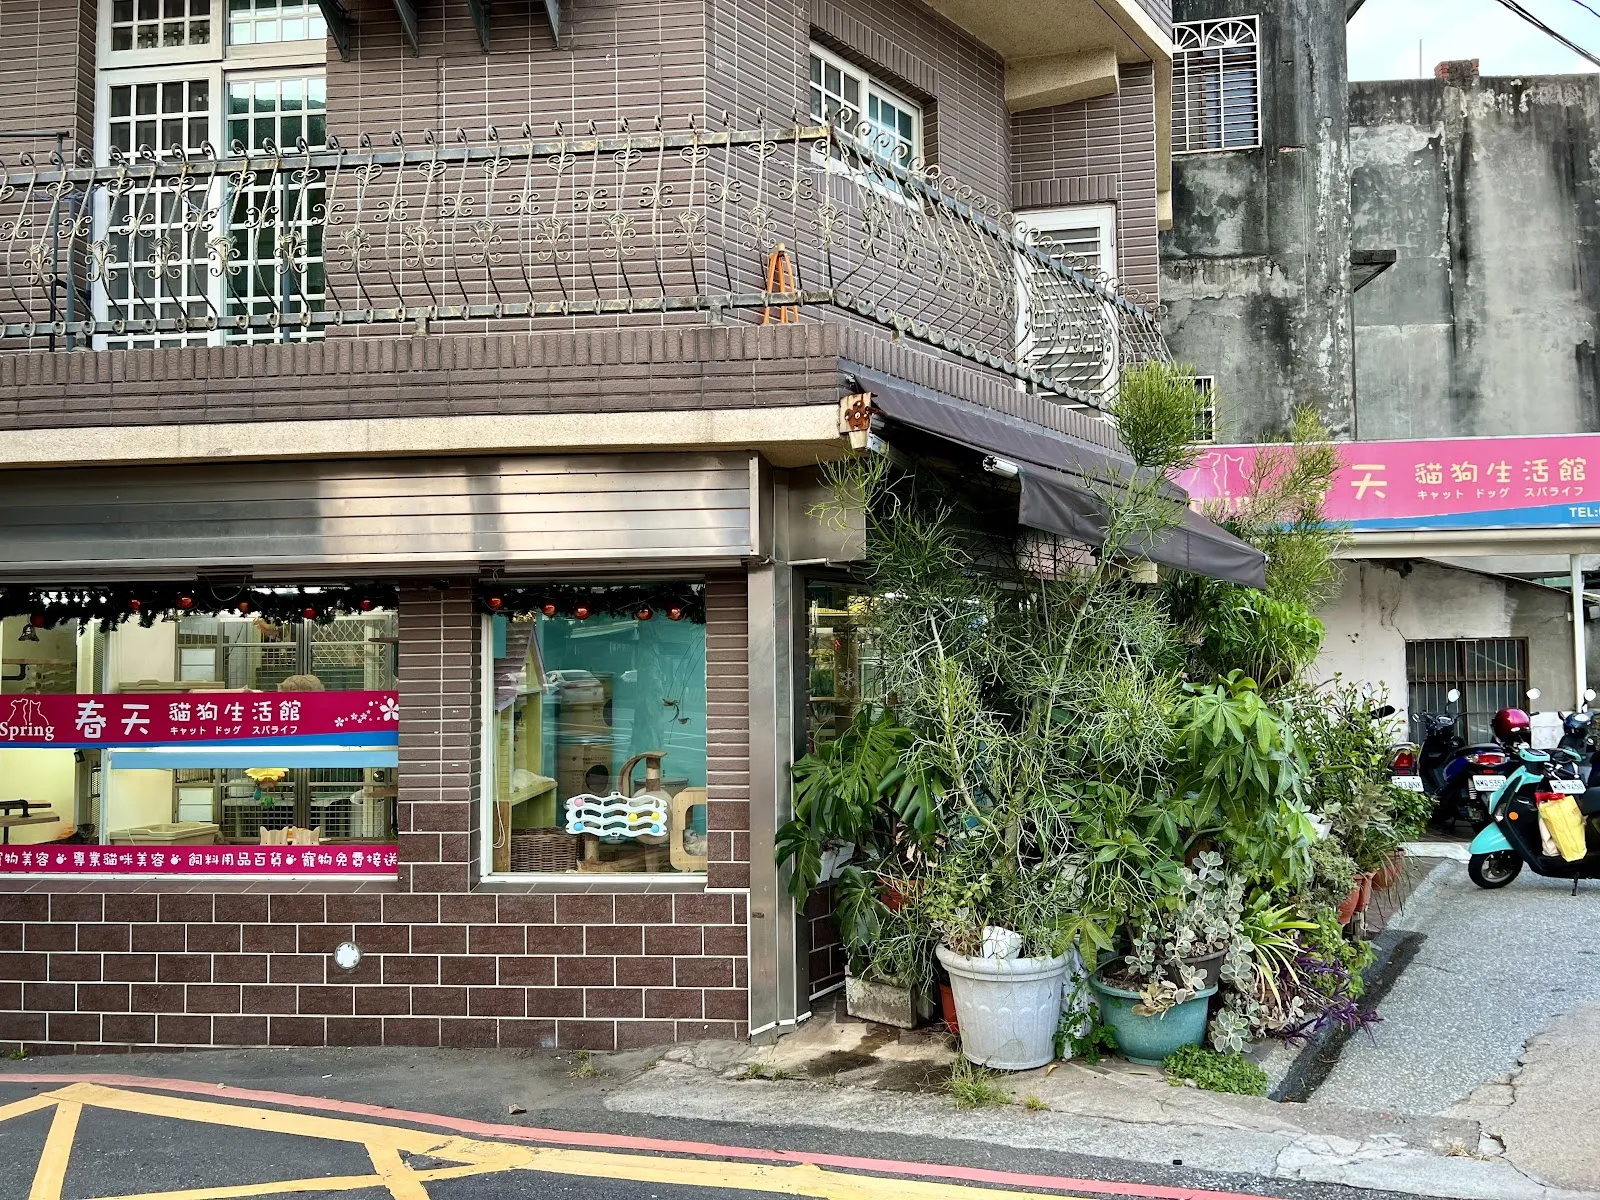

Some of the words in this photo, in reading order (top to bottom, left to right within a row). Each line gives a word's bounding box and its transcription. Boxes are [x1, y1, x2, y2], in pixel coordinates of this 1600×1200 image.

[1414, 457, 1587, 485] 貓狗生活館
[1417, 490, 1464, 500] キャット
[1476, 486, 1511, 499] ドッグ
[1568, 506, 1600, 518] TEL:
[75, 700, 151, 739] 春天
[168, 699, 302, 722] 貓狗生活館
[0, 721, 55, 742] Spring
[170, 726, 207, 736] キャット
[215, 725, 242, 735] ドッグ
